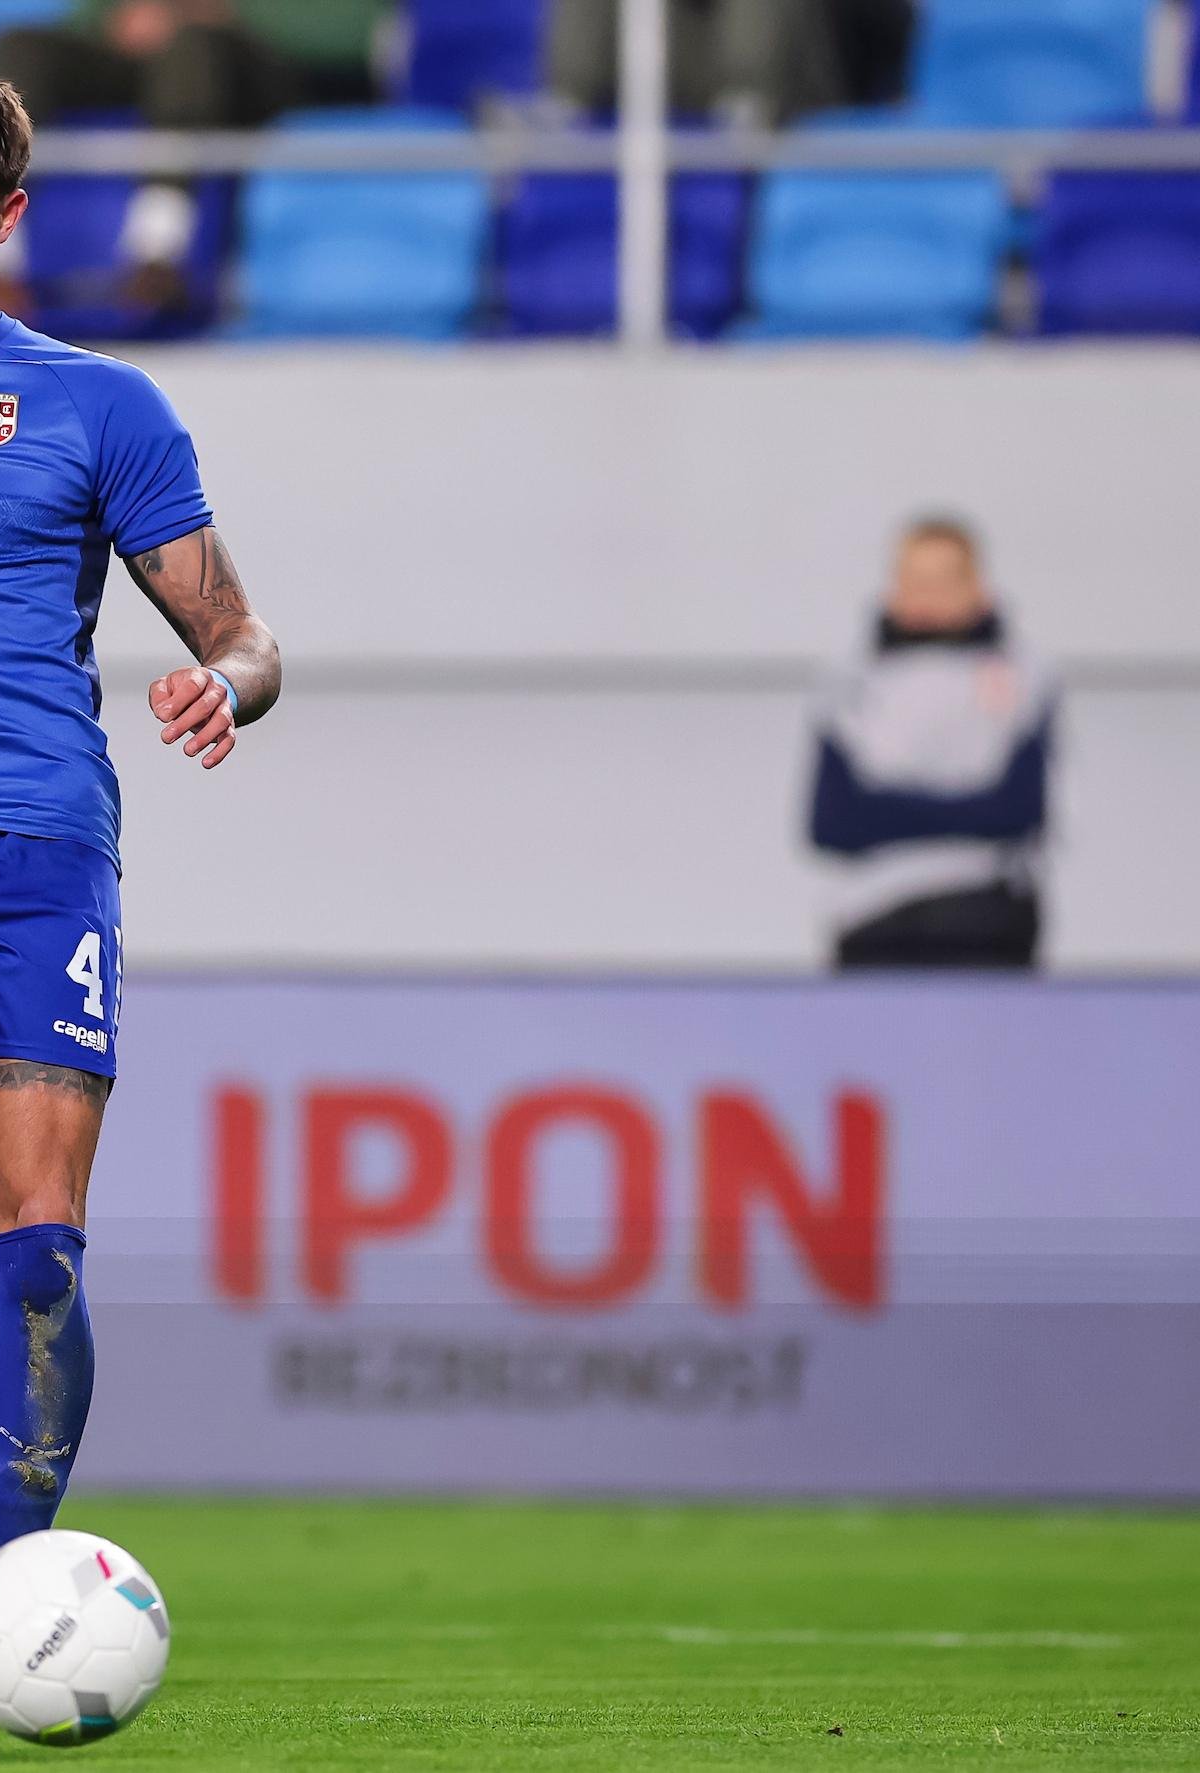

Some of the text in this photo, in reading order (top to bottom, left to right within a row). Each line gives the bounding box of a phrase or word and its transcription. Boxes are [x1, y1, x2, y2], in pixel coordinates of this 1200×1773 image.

[65, 931, 105, 1020] 4
[53, 1020, 108, 1050] capelli
[210, 1081, 887, 1314] IPON
[26, 1615, 77, 1671] capelli
